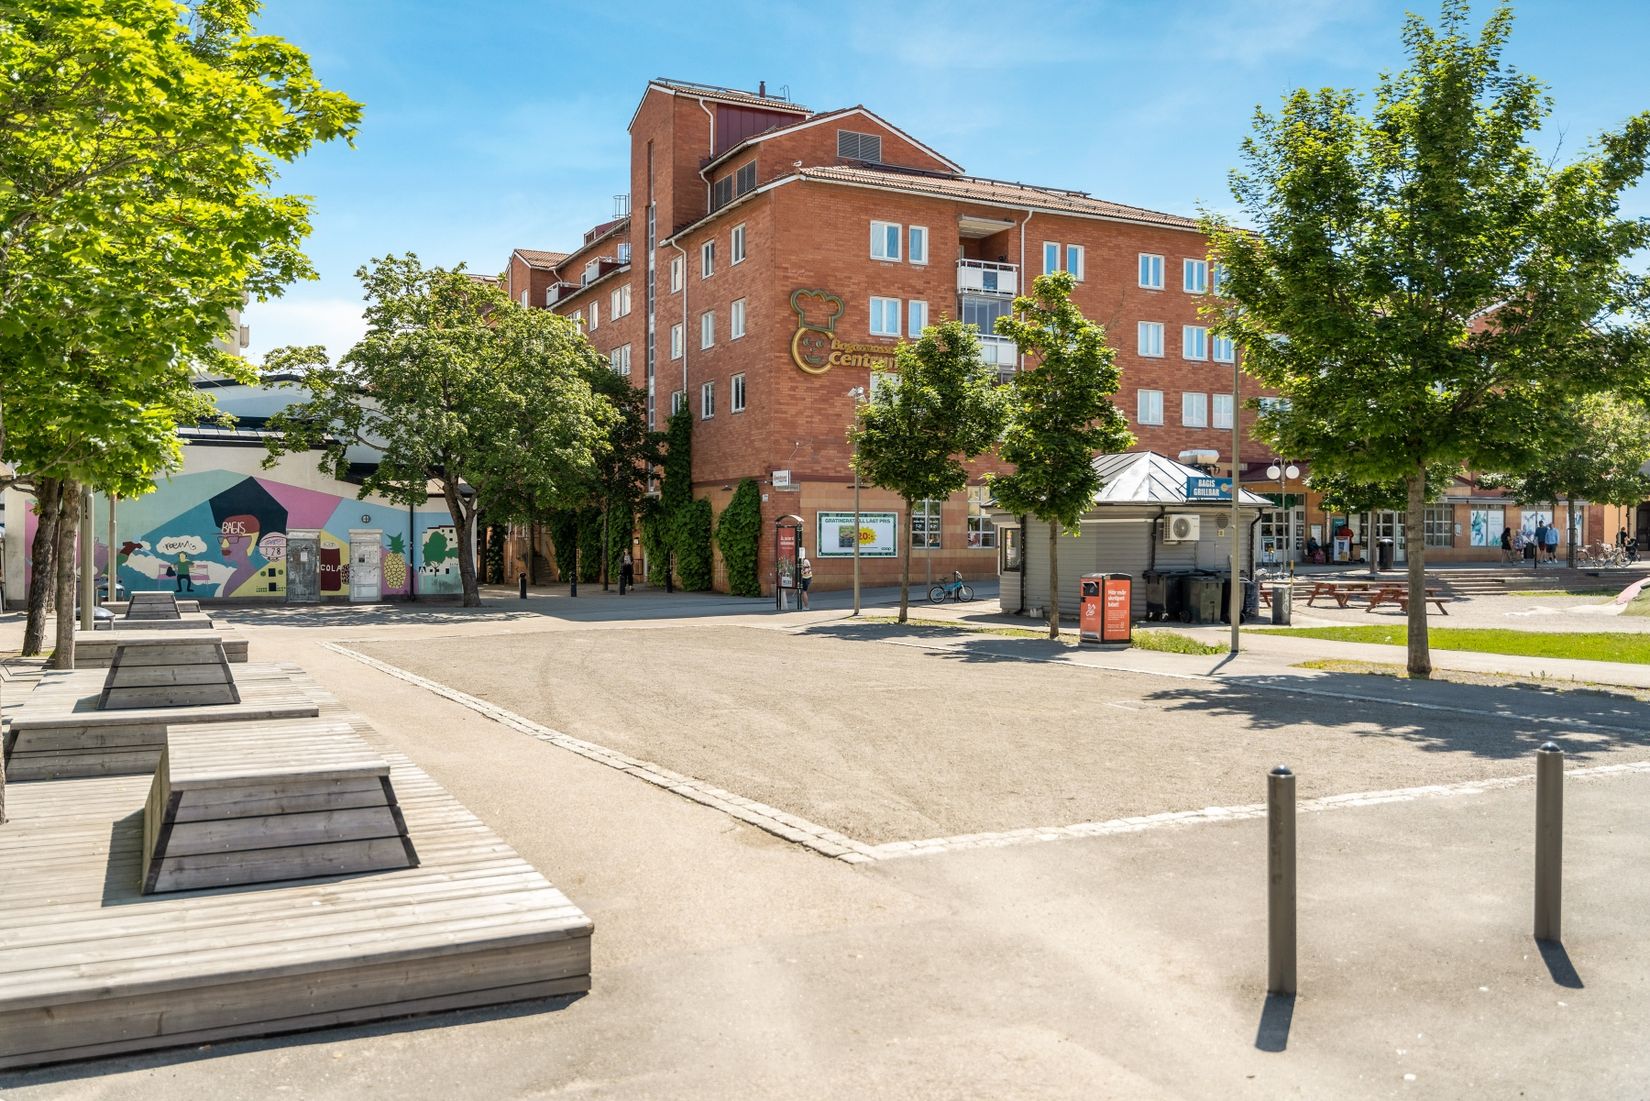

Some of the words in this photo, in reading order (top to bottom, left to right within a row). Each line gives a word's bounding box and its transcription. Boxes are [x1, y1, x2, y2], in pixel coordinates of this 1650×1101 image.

[831, 338, 896, 354] Bagarmosse
[1198, 479, 1216, 487] BAGIS
[1193, 488, 1220, 496] GRILLBAR
[221, 521, 246, 534] BAGIS
[320, 564, 342, 572] COLA
